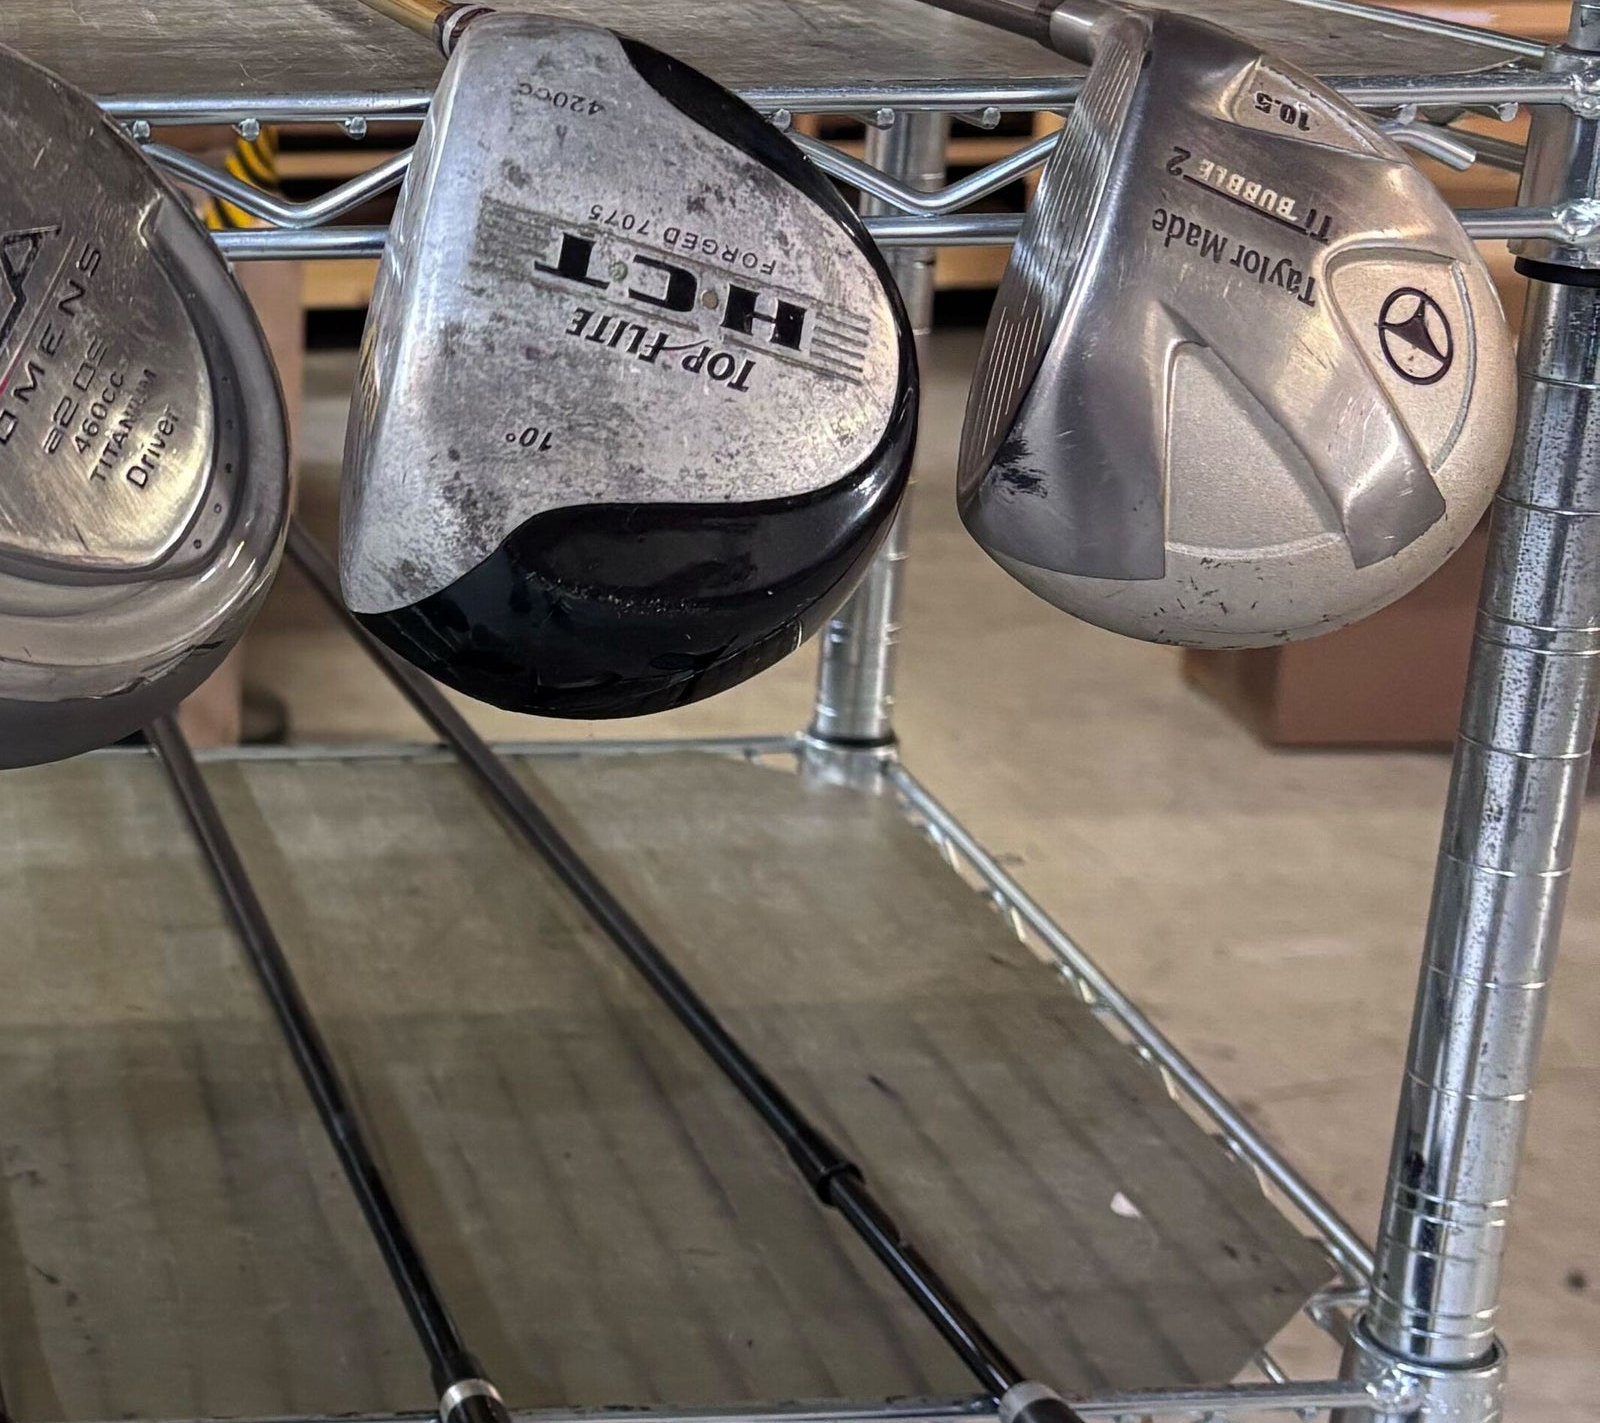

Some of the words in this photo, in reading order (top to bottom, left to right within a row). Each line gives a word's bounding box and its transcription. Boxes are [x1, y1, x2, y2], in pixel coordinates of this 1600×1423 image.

[517, 82, 605, 116] 420cc
[1254, 92, 1311, 131] 10.5
[1165, 146, 1192, 176] 2
[1199, 158, 1298, 221] BUBBLE
[589, 204, 651, 236] 7075
[1152, 208, 1228, 264] Made
[663, 226, 777, 276] FORGED
[1229, 244, 1317, 307] Taylor
[565, 307, 670, 363] FLITE
[681, 349, 757, 393] TOP
[90, 369, 158, 482] TITANIUM
[126, 404, 180, 490] Driver
[505, 427, 555, 452] 10°
